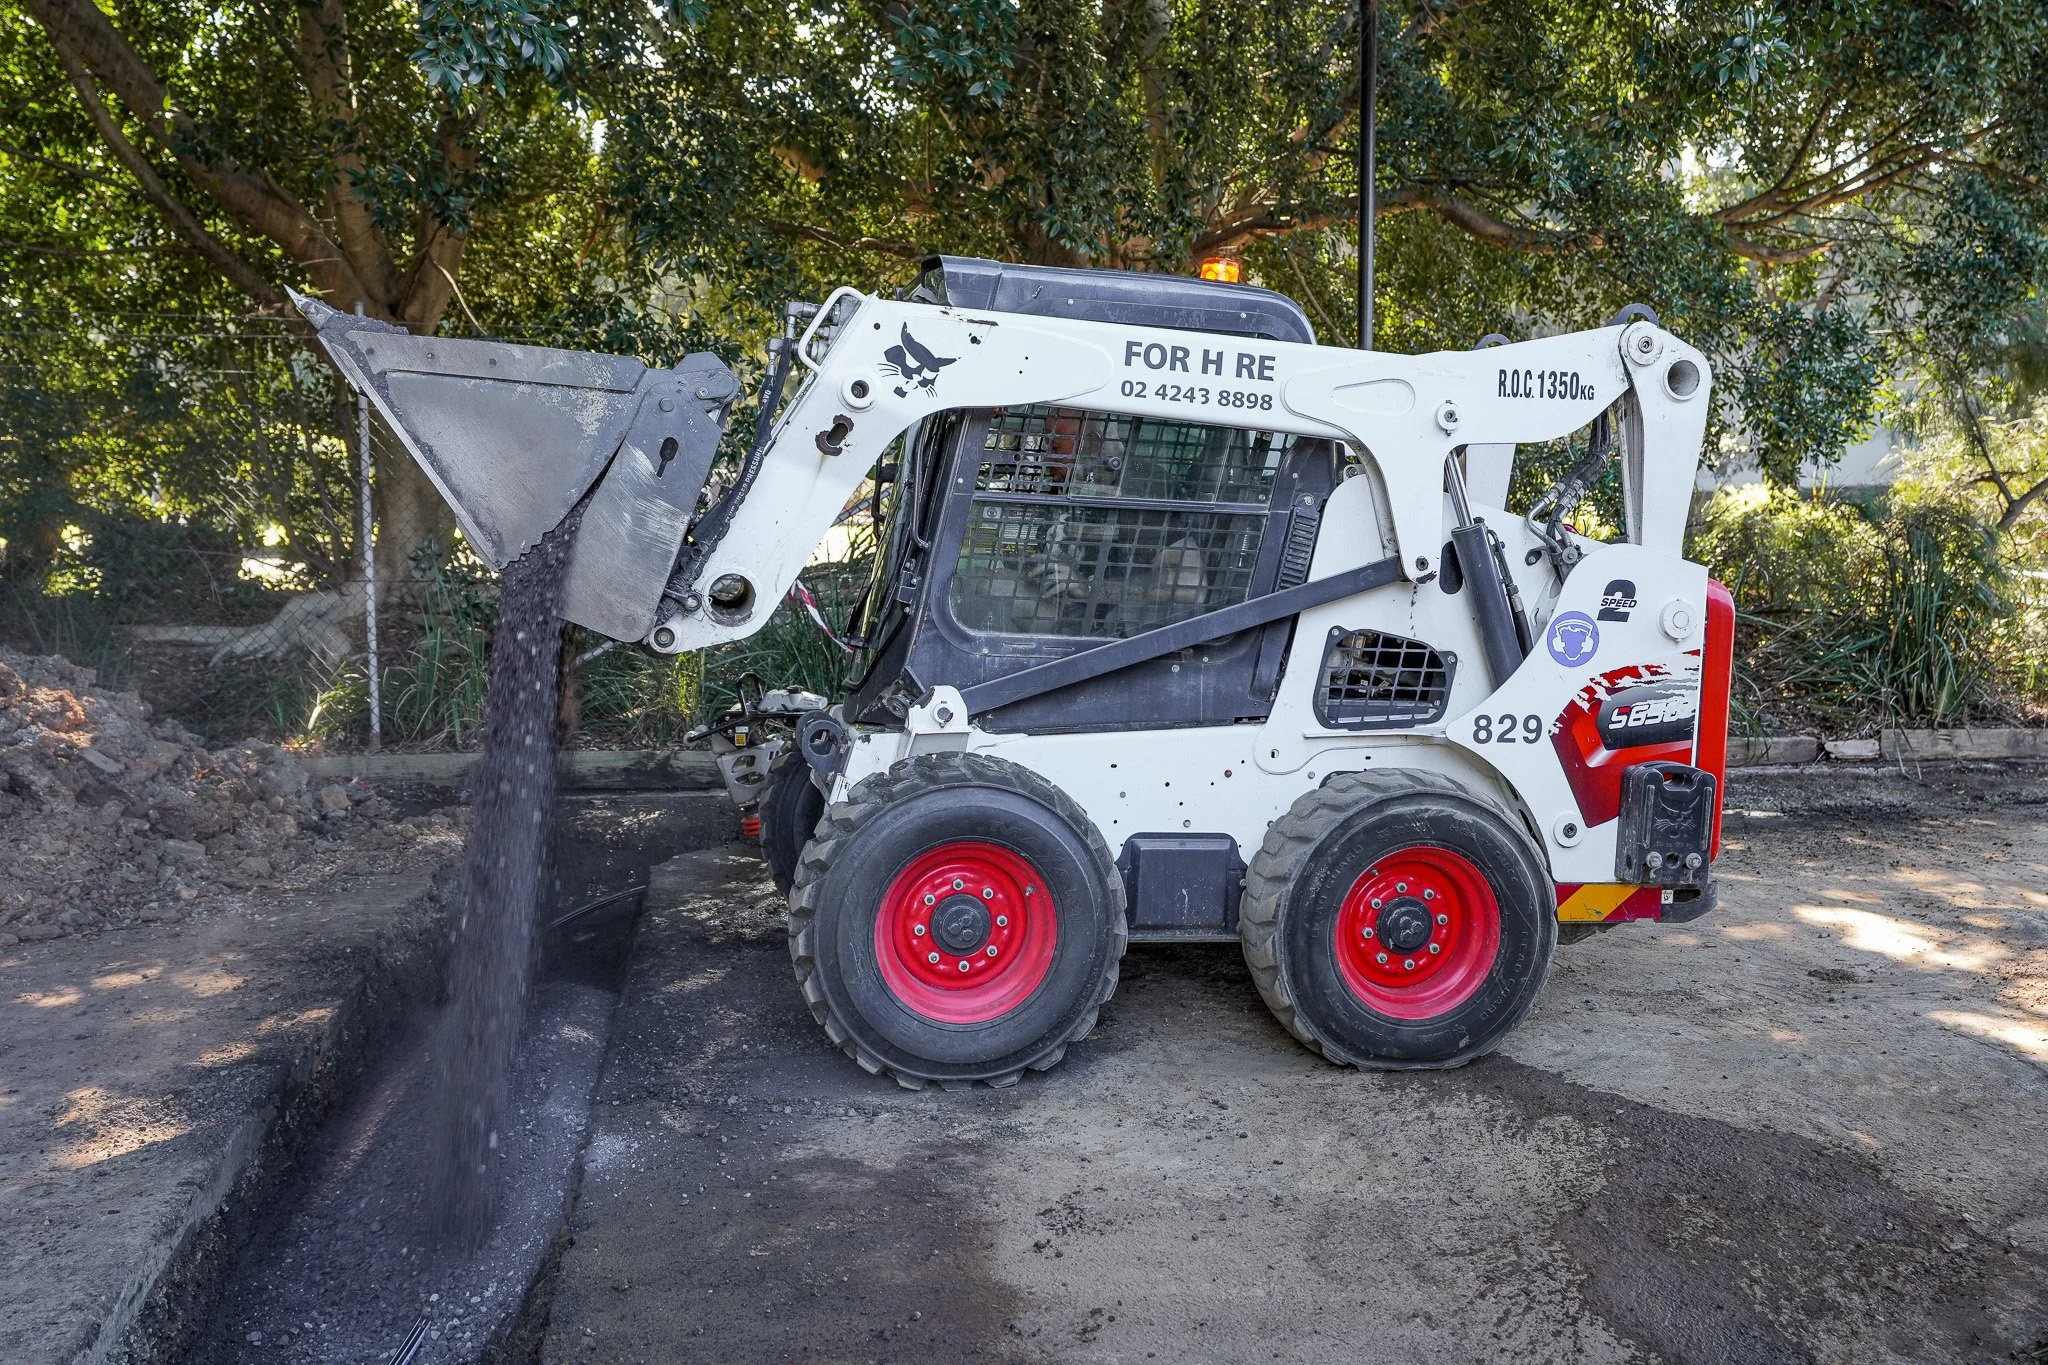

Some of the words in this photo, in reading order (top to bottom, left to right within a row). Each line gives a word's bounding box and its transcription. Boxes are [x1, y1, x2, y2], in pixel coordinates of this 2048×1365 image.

[1124, 340, 1190, 373] FOR
[1120, 379, 1147, 399] 02
[1154, 384, 1210, 404] 4243
[1217, 389, 1273, 411] 8898
[1597, 579, 1636, 622] 2
[1600, 598, 1637, 608] SPEED
[1472, 713, 1543, 745] 829
